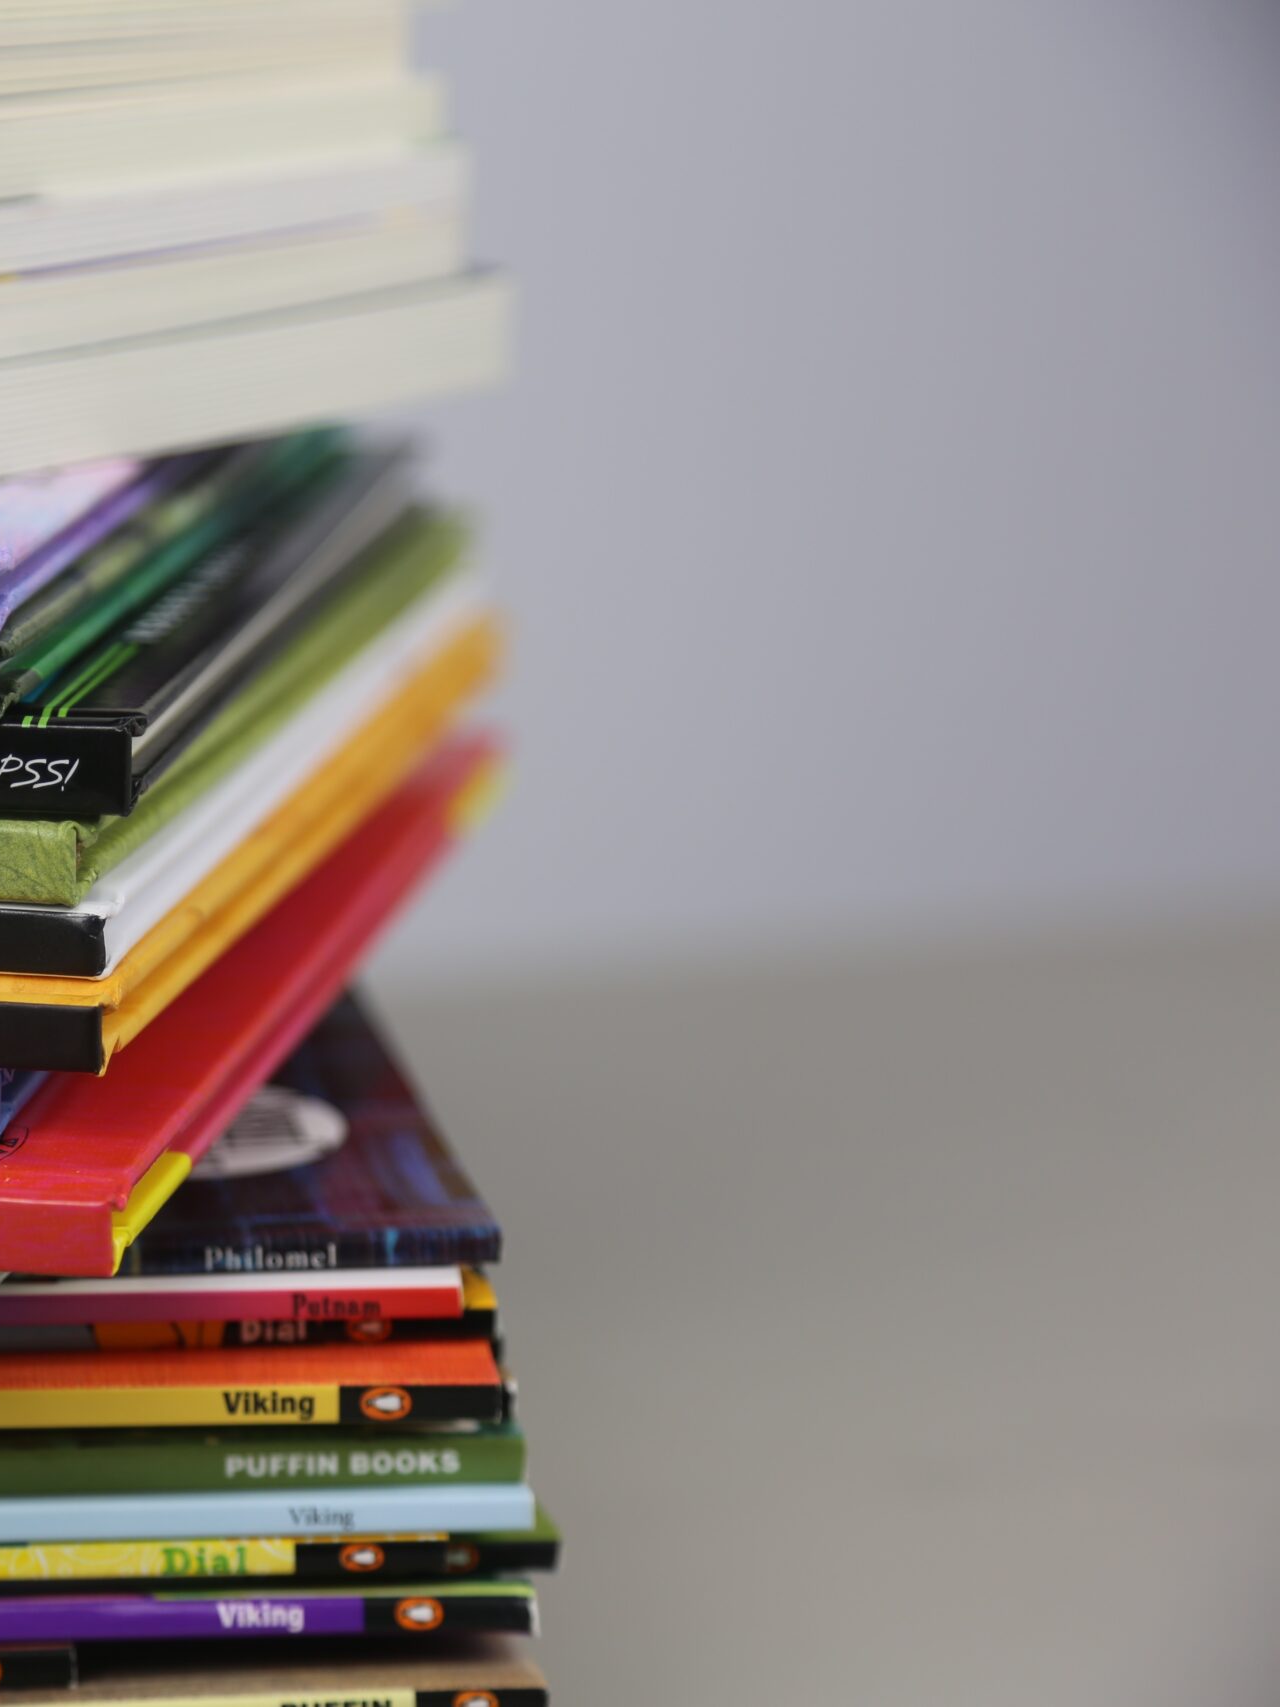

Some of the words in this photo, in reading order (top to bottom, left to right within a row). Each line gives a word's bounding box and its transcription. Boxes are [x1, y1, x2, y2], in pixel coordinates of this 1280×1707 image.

[204, 1243, 337, 1271] Philomel
[291, 1292, 381, 1320] Putnam
[223, 1391, 315, 1421] Viking
[225, 1451, 339, 1478] PUFFIN
[350, 1449, 460, 1476] BOOKS
[288, 1506, 354, 1529] Viking
[162, 1546, 249, 1576] Dial
[216, 1602, 305, 1634] Viking
